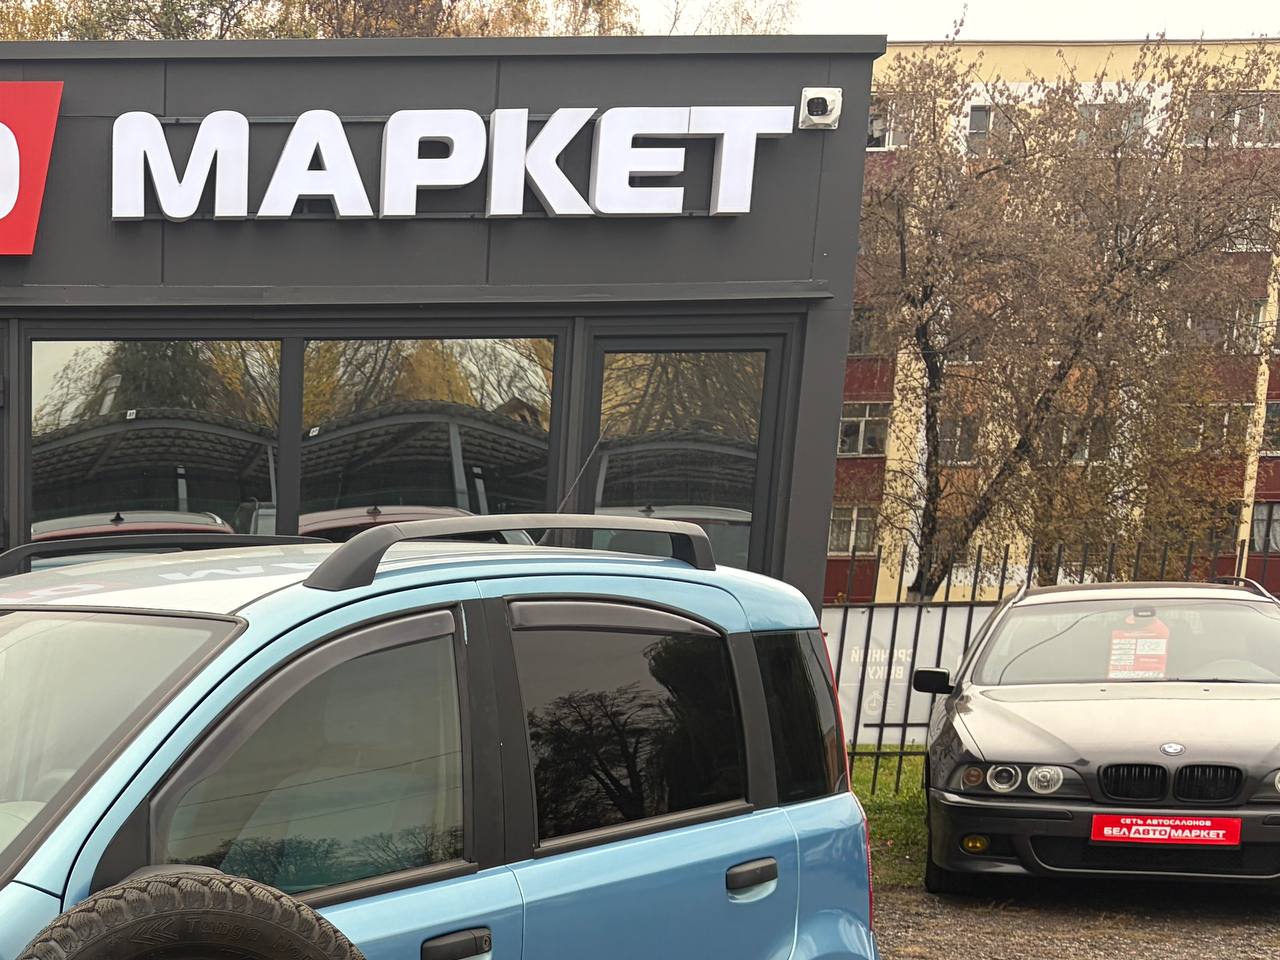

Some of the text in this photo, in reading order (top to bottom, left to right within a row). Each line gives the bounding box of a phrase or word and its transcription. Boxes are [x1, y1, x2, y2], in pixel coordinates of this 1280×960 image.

[111, 105, 795, 222] МАРКЕТ
[1104, 827, 1227, 838] БЕЛ АВТО МАРКЕТ
